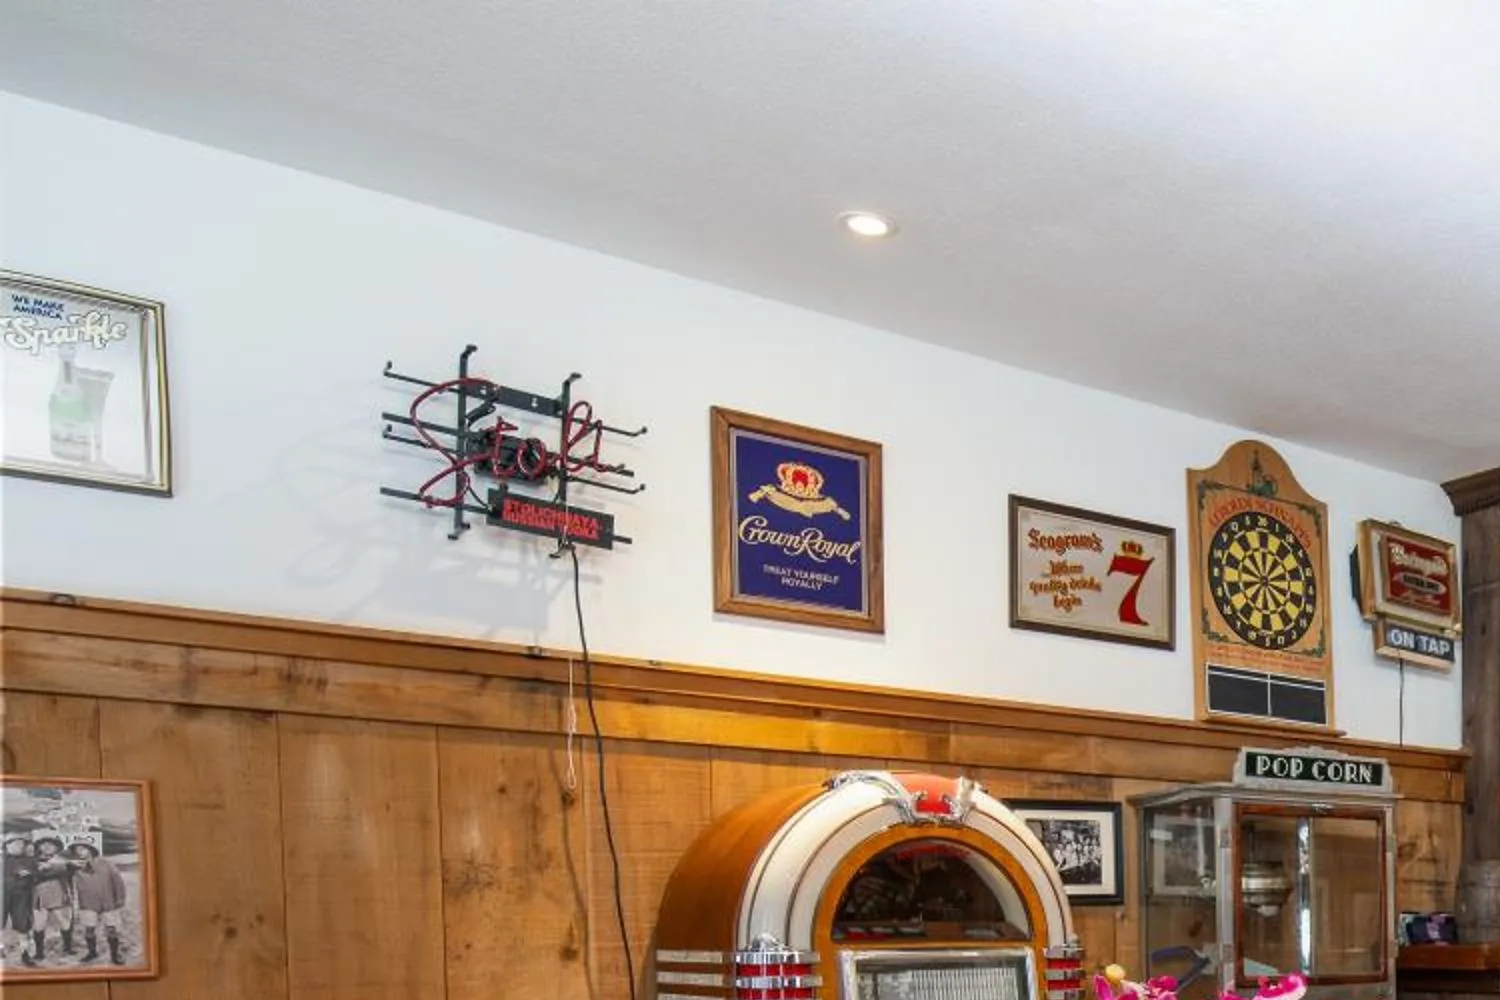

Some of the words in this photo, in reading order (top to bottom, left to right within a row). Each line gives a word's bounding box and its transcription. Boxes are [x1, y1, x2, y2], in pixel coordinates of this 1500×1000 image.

[11, 294, 32, 303] WE
[34, 299, 65, 312] MAKE
[13, 304, 63, 320] AMERICA
[3, 307, 129, 356] Sparkle
[738, 515, 800, 549] Crown
[788, 528, 862, 564] Royal
[1028, 527, 1104, 557] Seagram's
[1106, 552, 1156, 626] 7
[1390, 628, 1414, 649] ON
[1417, 635, 1451, 656] TAP
[1255, 755, 1303, 778] POP
[1311, 759, 1373, 783] CORN
